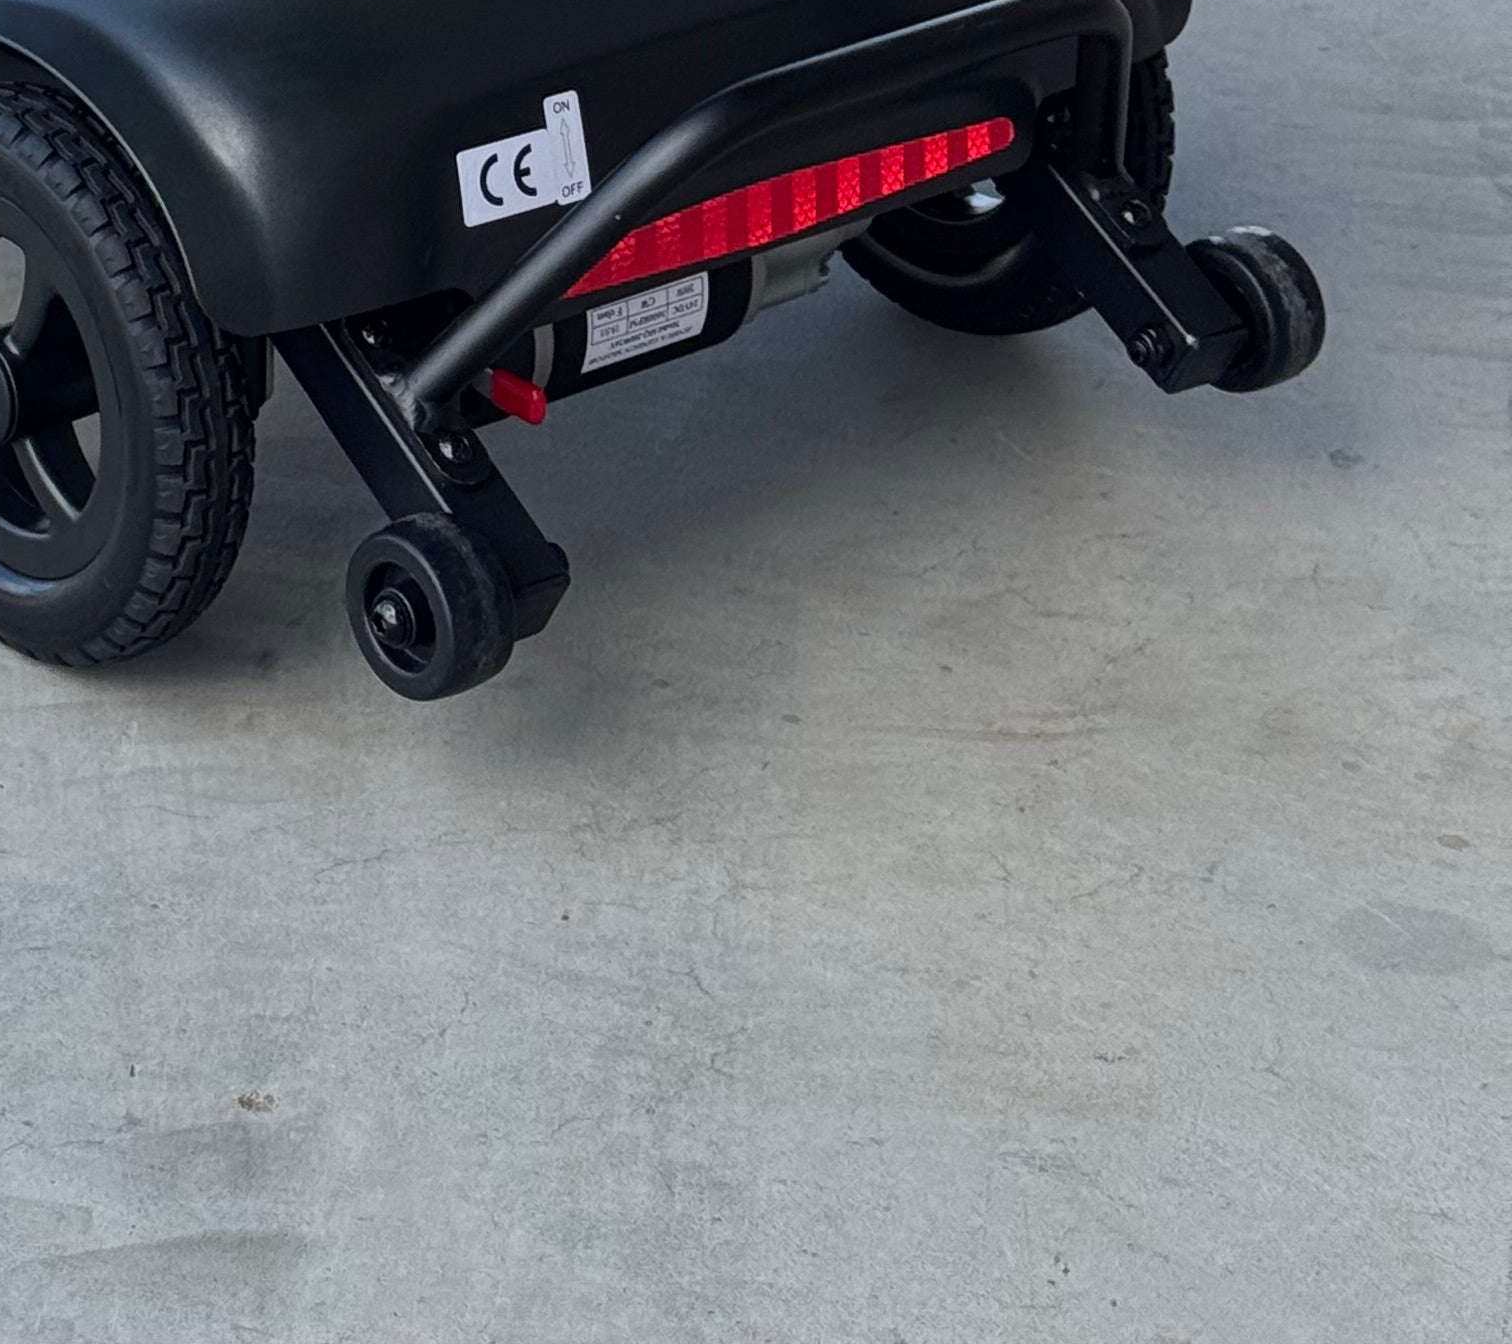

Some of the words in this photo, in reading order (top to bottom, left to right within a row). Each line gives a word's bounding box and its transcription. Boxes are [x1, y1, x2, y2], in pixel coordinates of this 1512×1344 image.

[552, 100, 570, 114] ON
[479, 143, 538, 206] CE
[561, 180, 584, 198] OFF
